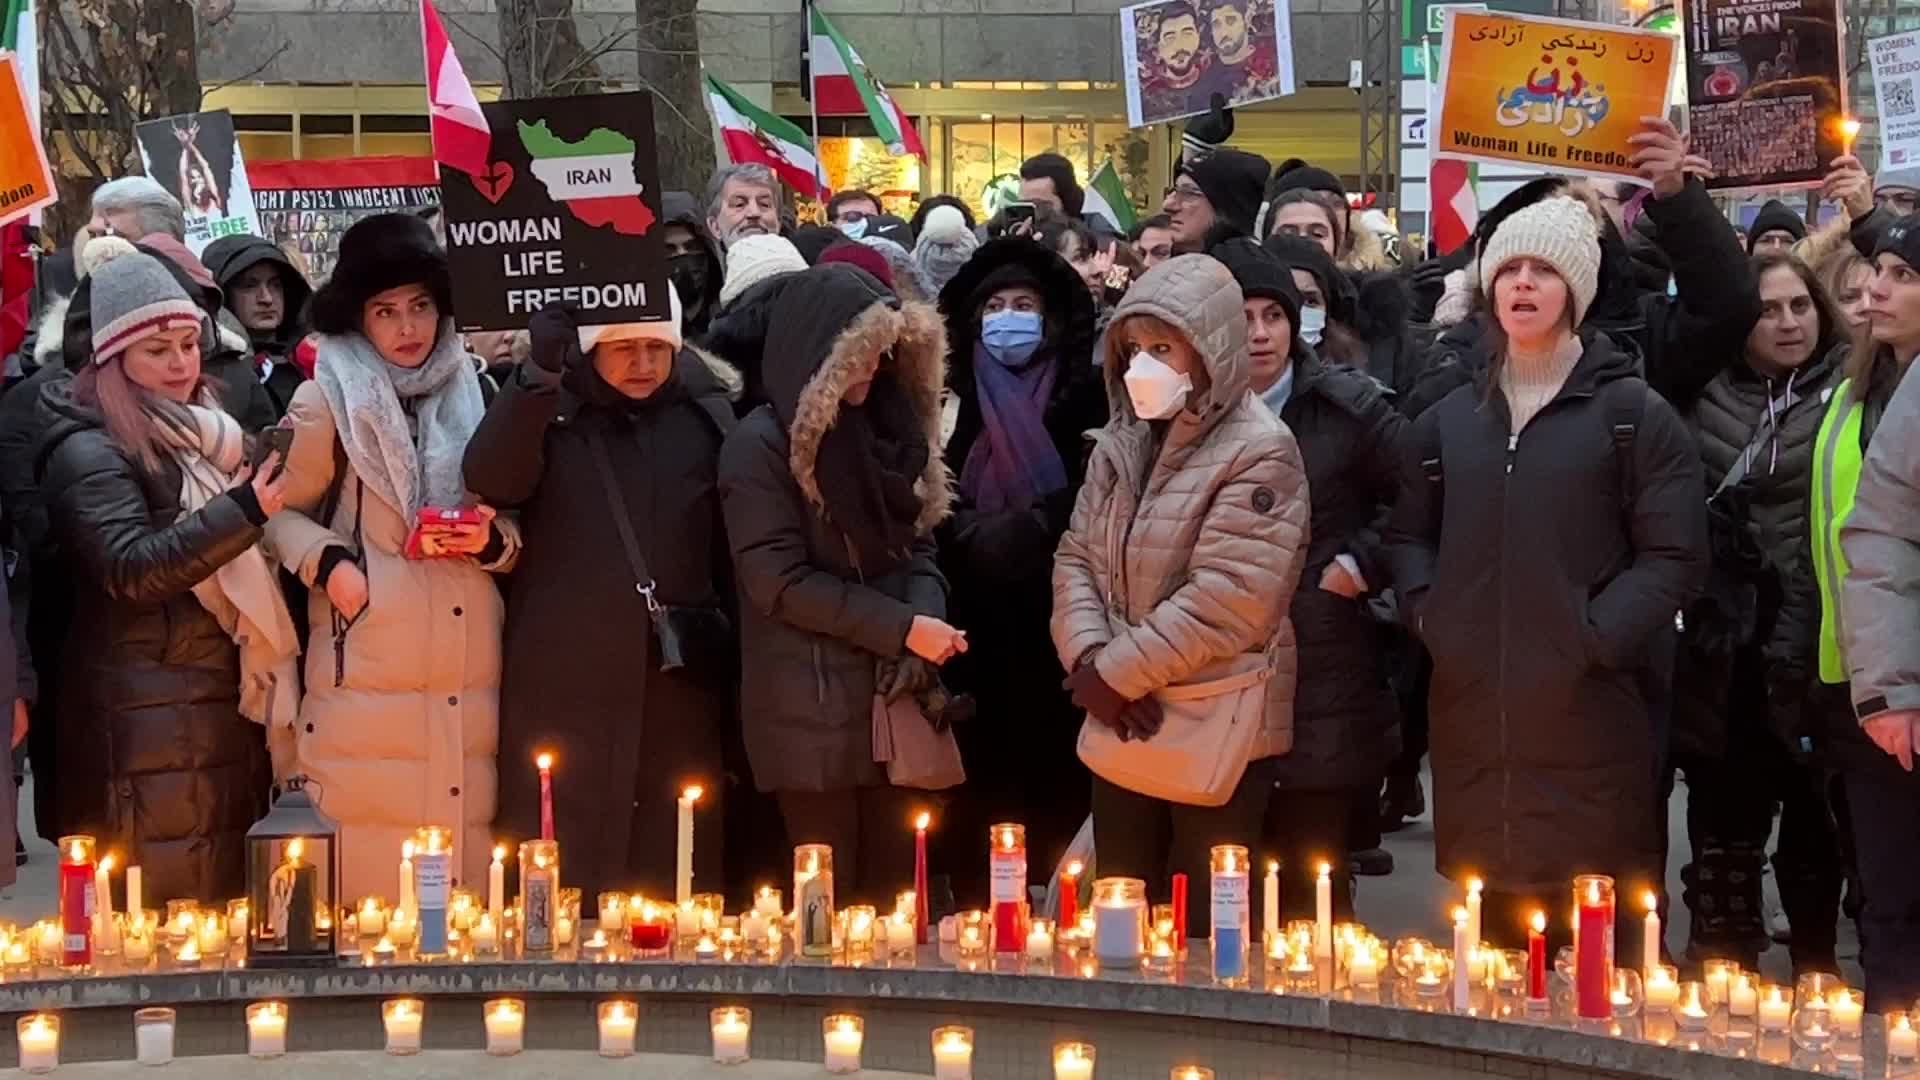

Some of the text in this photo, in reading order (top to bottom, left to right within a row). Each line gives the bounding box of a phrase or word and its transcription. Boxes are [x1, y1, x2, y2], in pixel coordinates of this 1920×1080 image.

[1717, 12, 1780, 36] IRAN
[1879, 60, 1920, 77] FREEDO
[1454, 130, 1518, 153] Woman
[1527, 140, 1557, 158] Life
[567, 168, 612, 186] IRAN
[254, 190, 285, 209] IGHT
[292, 189, 335, 209] PS752
[338, 187, 407, 209] INNOCENT
[210, 216, 249, 237] FREE
[450, 217, 562, 247] WOMAN
[503, 250, 564, 276] LIFE
